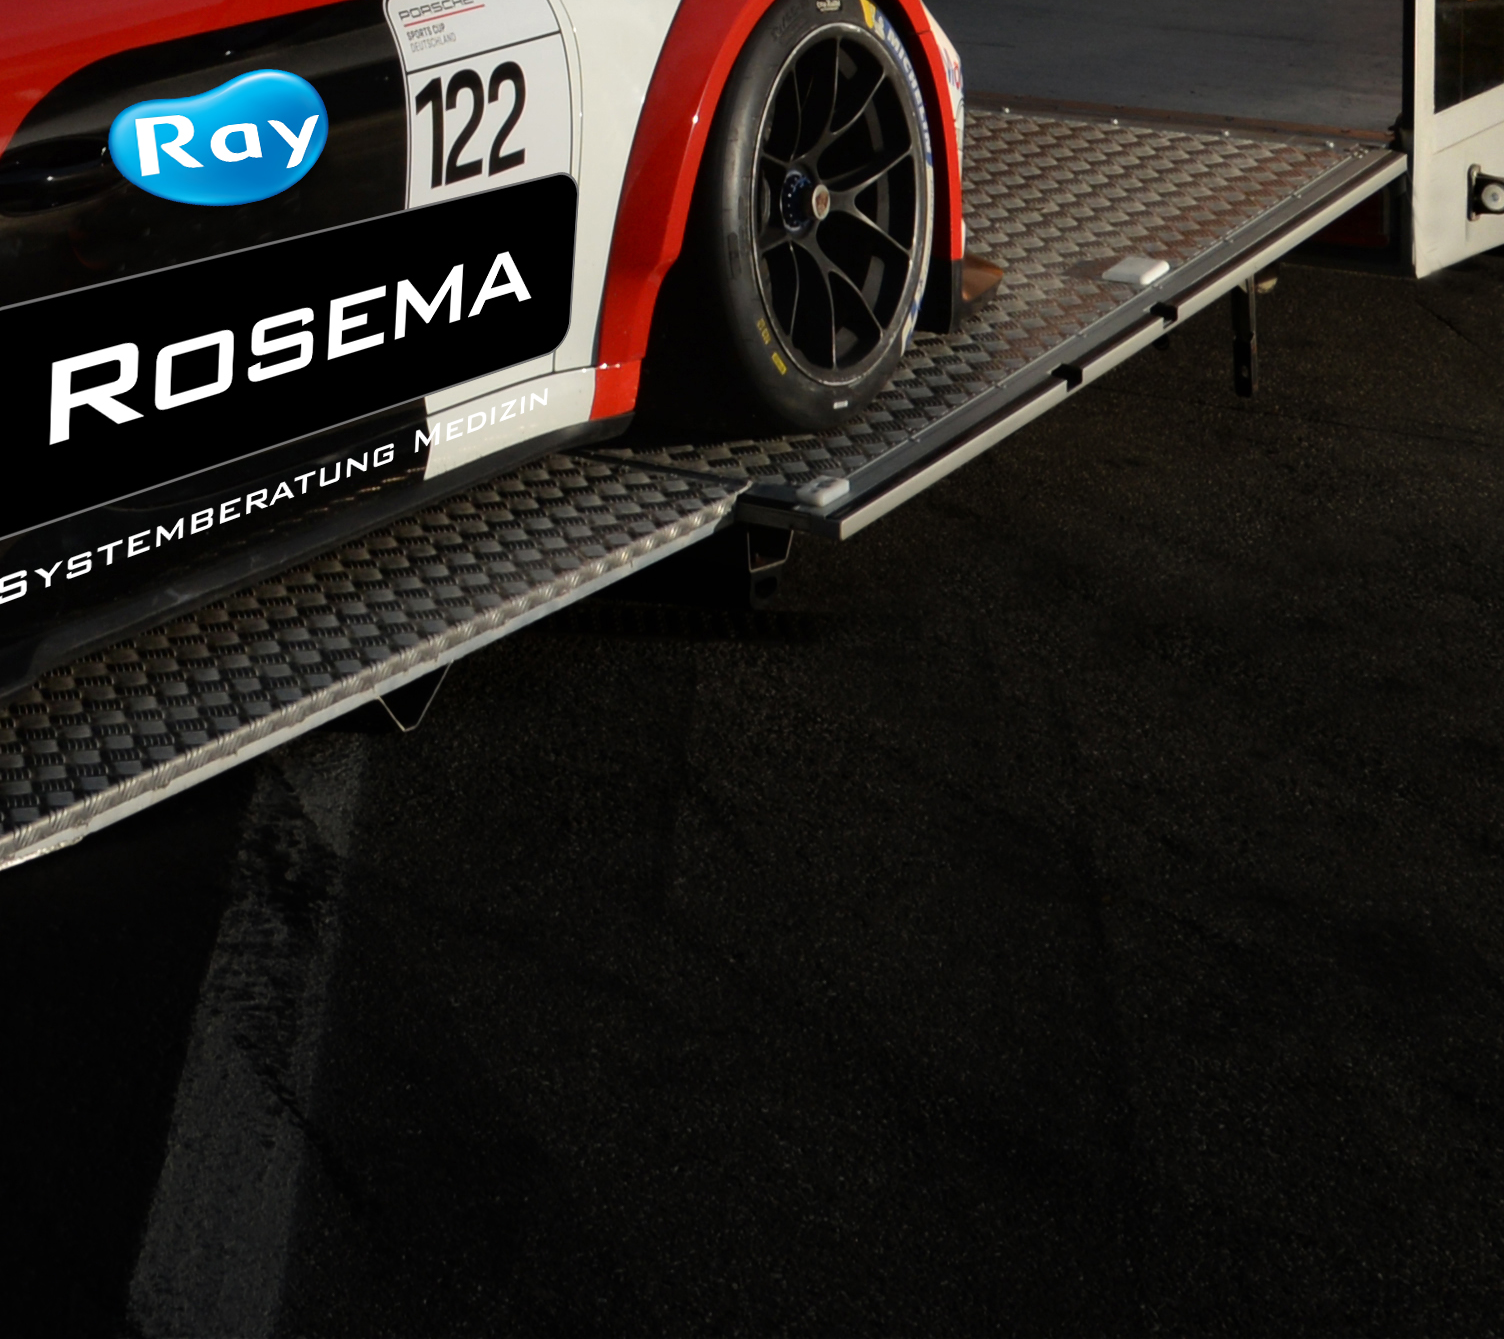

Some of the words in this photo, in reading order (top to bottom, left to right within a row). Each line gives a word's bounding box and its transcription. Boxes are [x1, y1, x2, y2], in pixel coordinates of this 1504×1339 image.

[406, 26, 433, 41] SPORTS
[432, 22, 445, 34] CUP
[410, 32, 457, 53] DEUTSCHLAND
[135, 115, 319, 177] Ray
[415, 61, 525, 189] 122
[49, 250, 532, 446] ROSEMA
[414, 387, 548, 453] MEDIZIN
